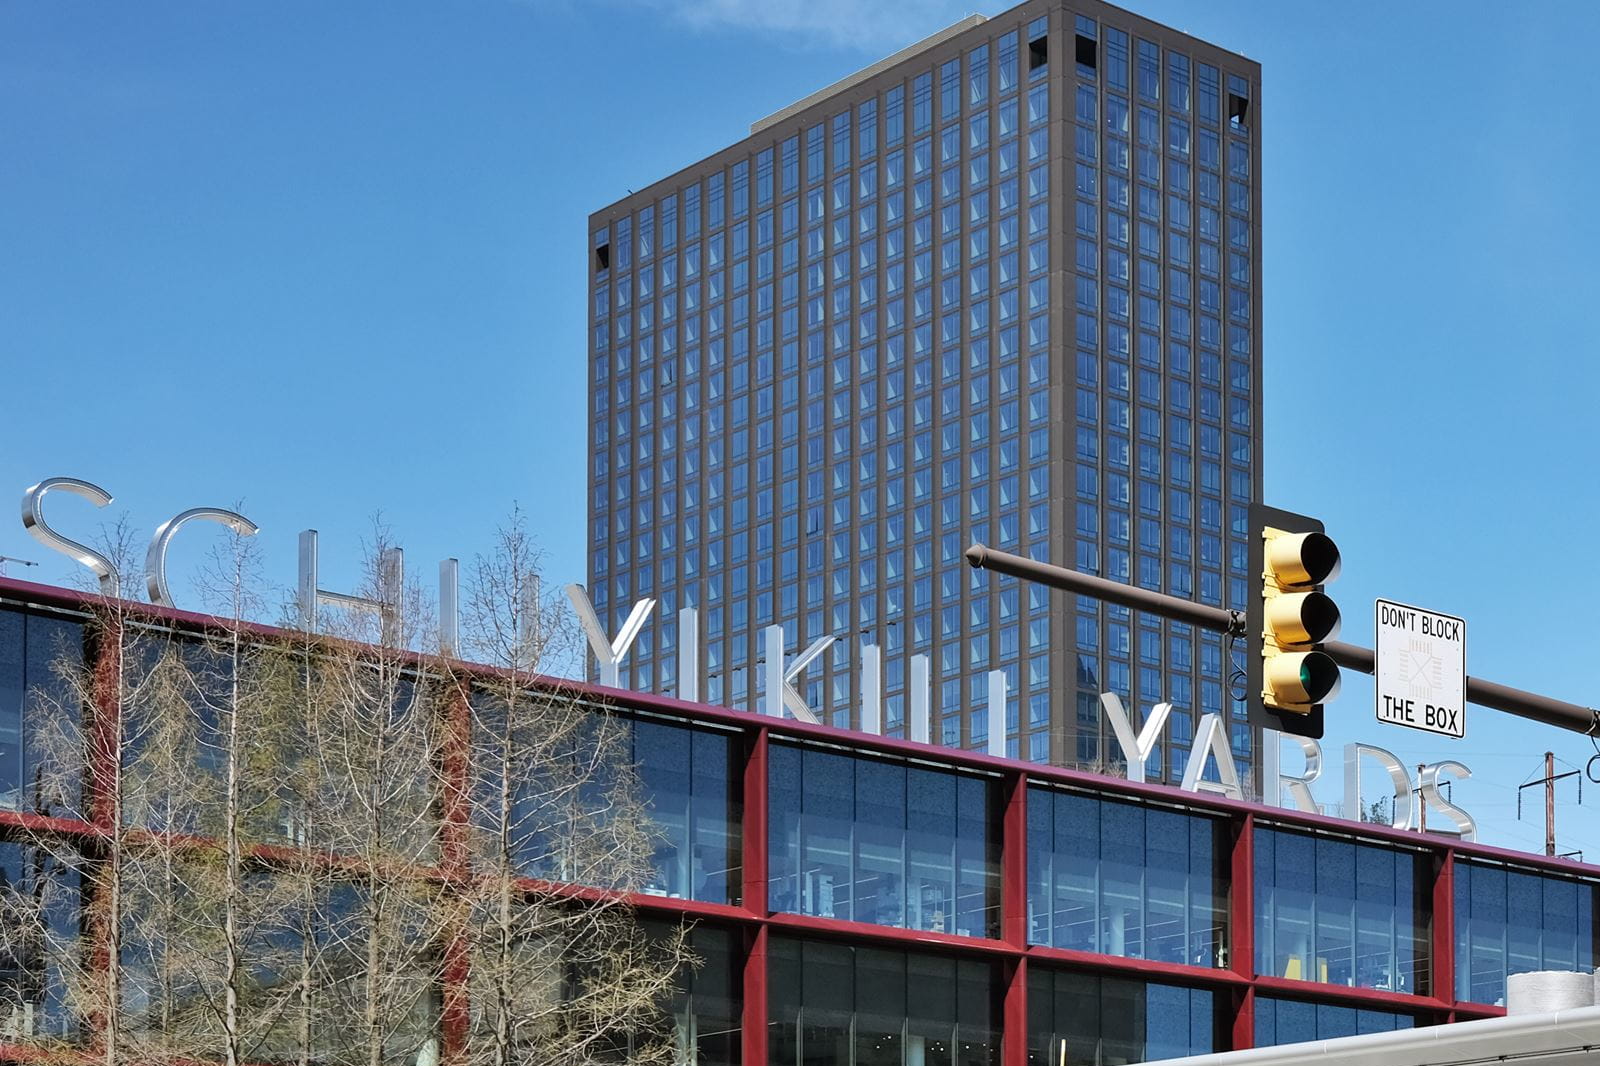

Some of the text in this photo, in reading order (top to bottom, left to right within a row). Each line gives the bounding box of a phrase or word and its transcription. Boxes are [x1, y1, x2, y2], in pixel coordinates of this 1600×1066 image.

[1381, 605, 1460, 642] DON'T BLOCK
[1383, 695, 1458, 734] THE BOX
[1100, 692, 1477, 843] YARDS
